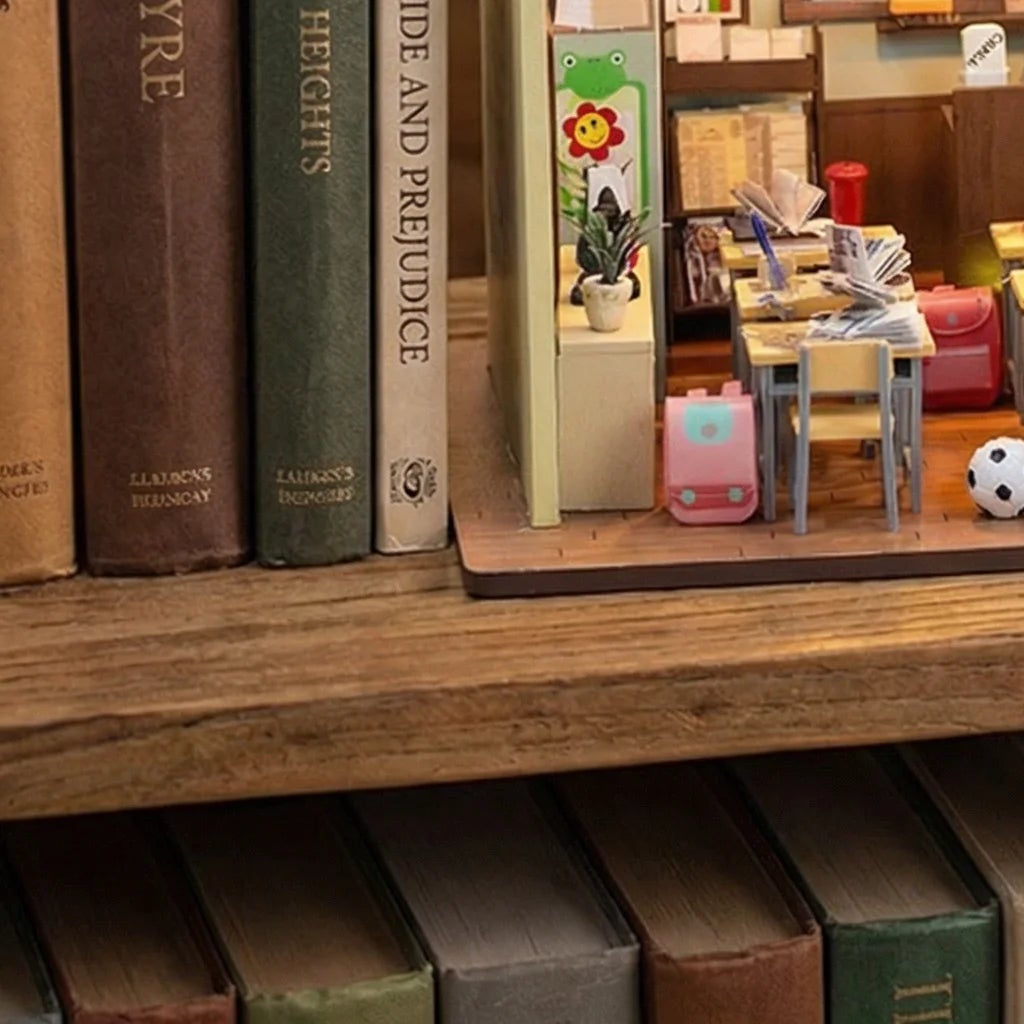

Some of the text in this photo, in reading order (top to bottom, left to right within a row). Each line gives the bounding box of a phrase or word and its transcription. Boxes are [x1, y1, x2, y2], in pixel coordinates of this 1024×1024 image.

[300, 8, 332, 175] HEIGHTS
[400, 74, 430, 155] AND
[392, 166, 430, 365] PREJUDICE
